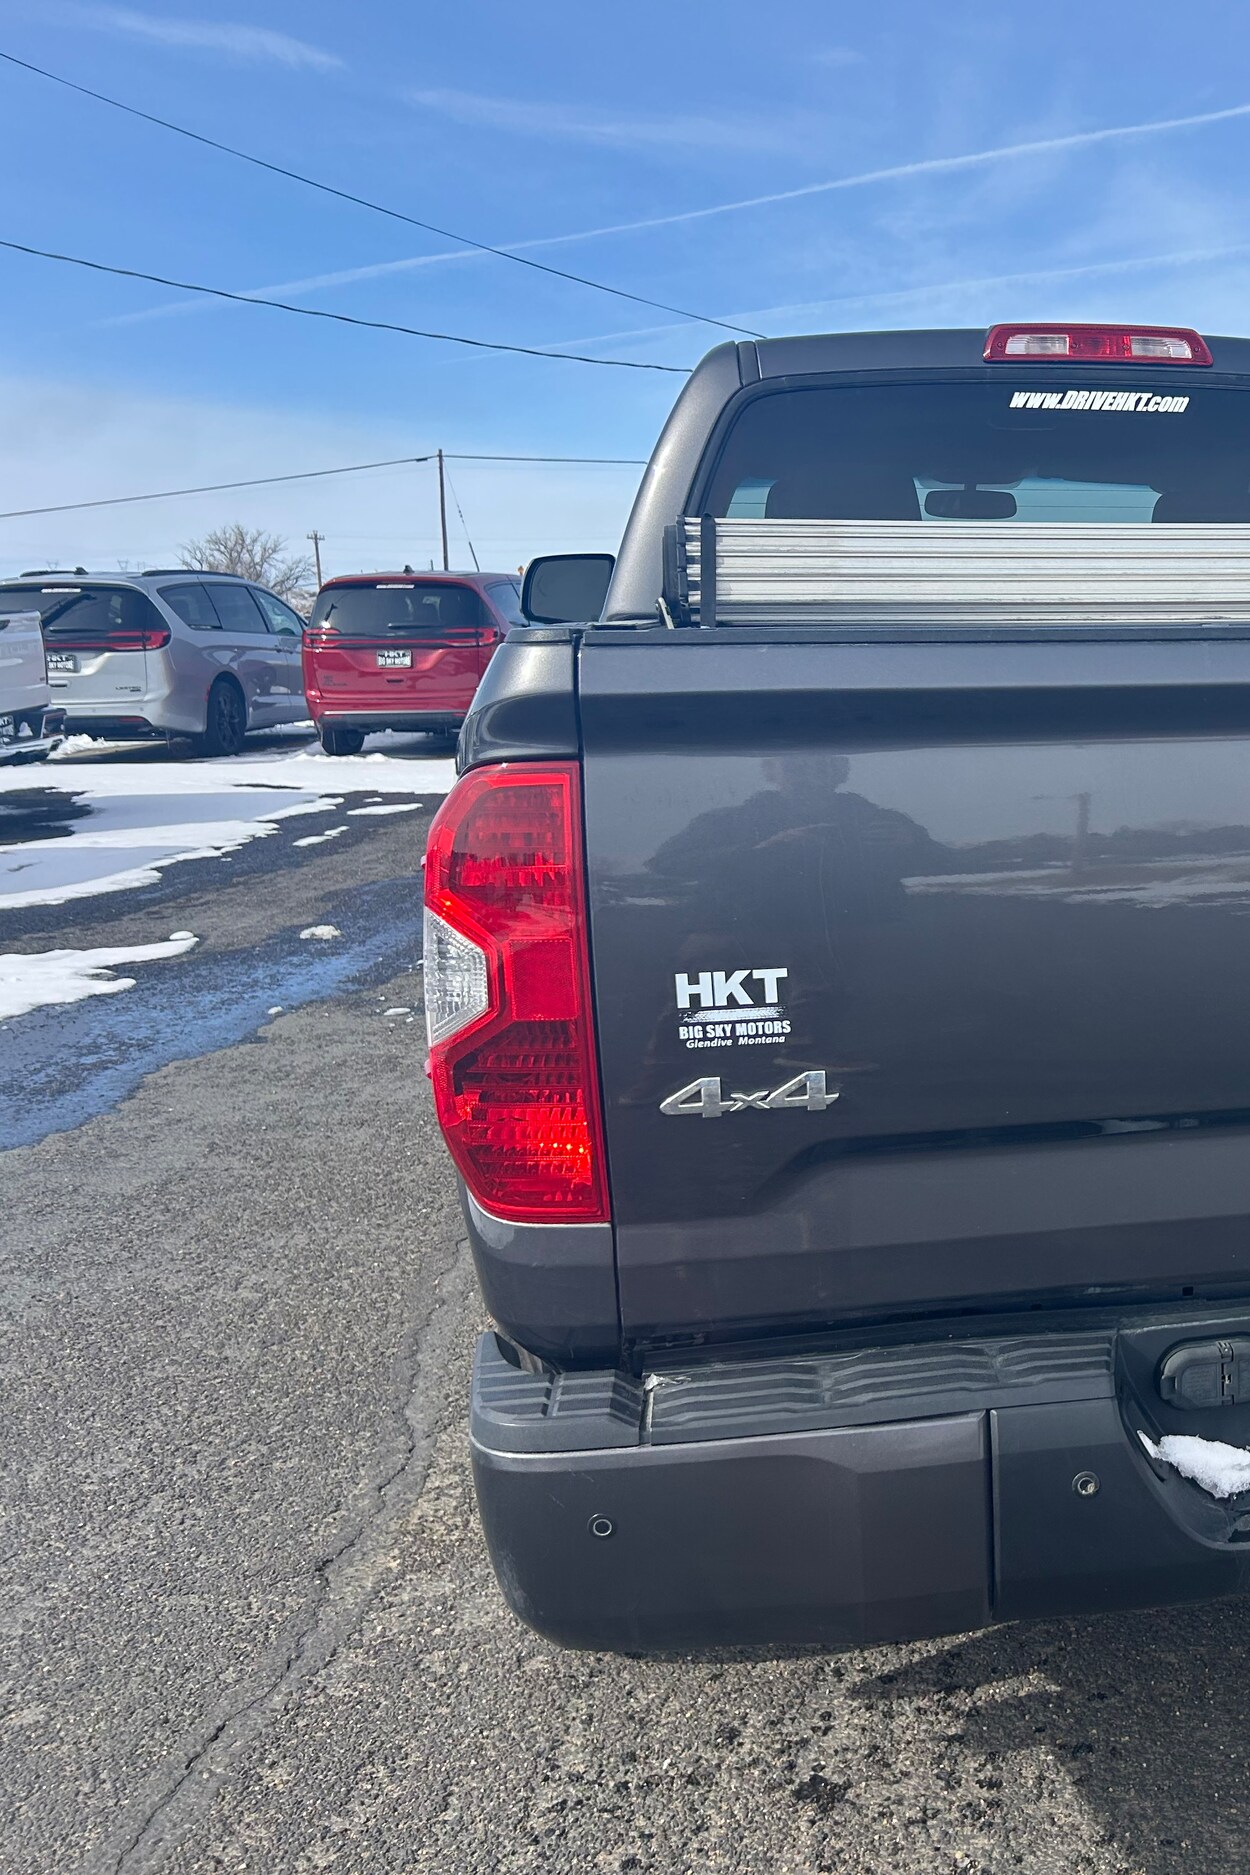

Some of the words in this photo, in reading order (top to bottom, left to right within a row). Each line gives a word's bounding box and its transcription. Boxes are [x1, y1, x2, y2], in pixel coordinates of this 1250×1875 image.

[1009, 391, 1190, 412] www.DRIVEHKT.com
[675, 968, 788, 1009] HKT
[679, 1026, 704, 1040] BIG
[706, 1023, 733, 1039] SKY
[736, 1020, 792, 1037] MOTORS
[686, 1038, 733, 1049] Glendive
[738, 1035, 786, 1046] Montana
